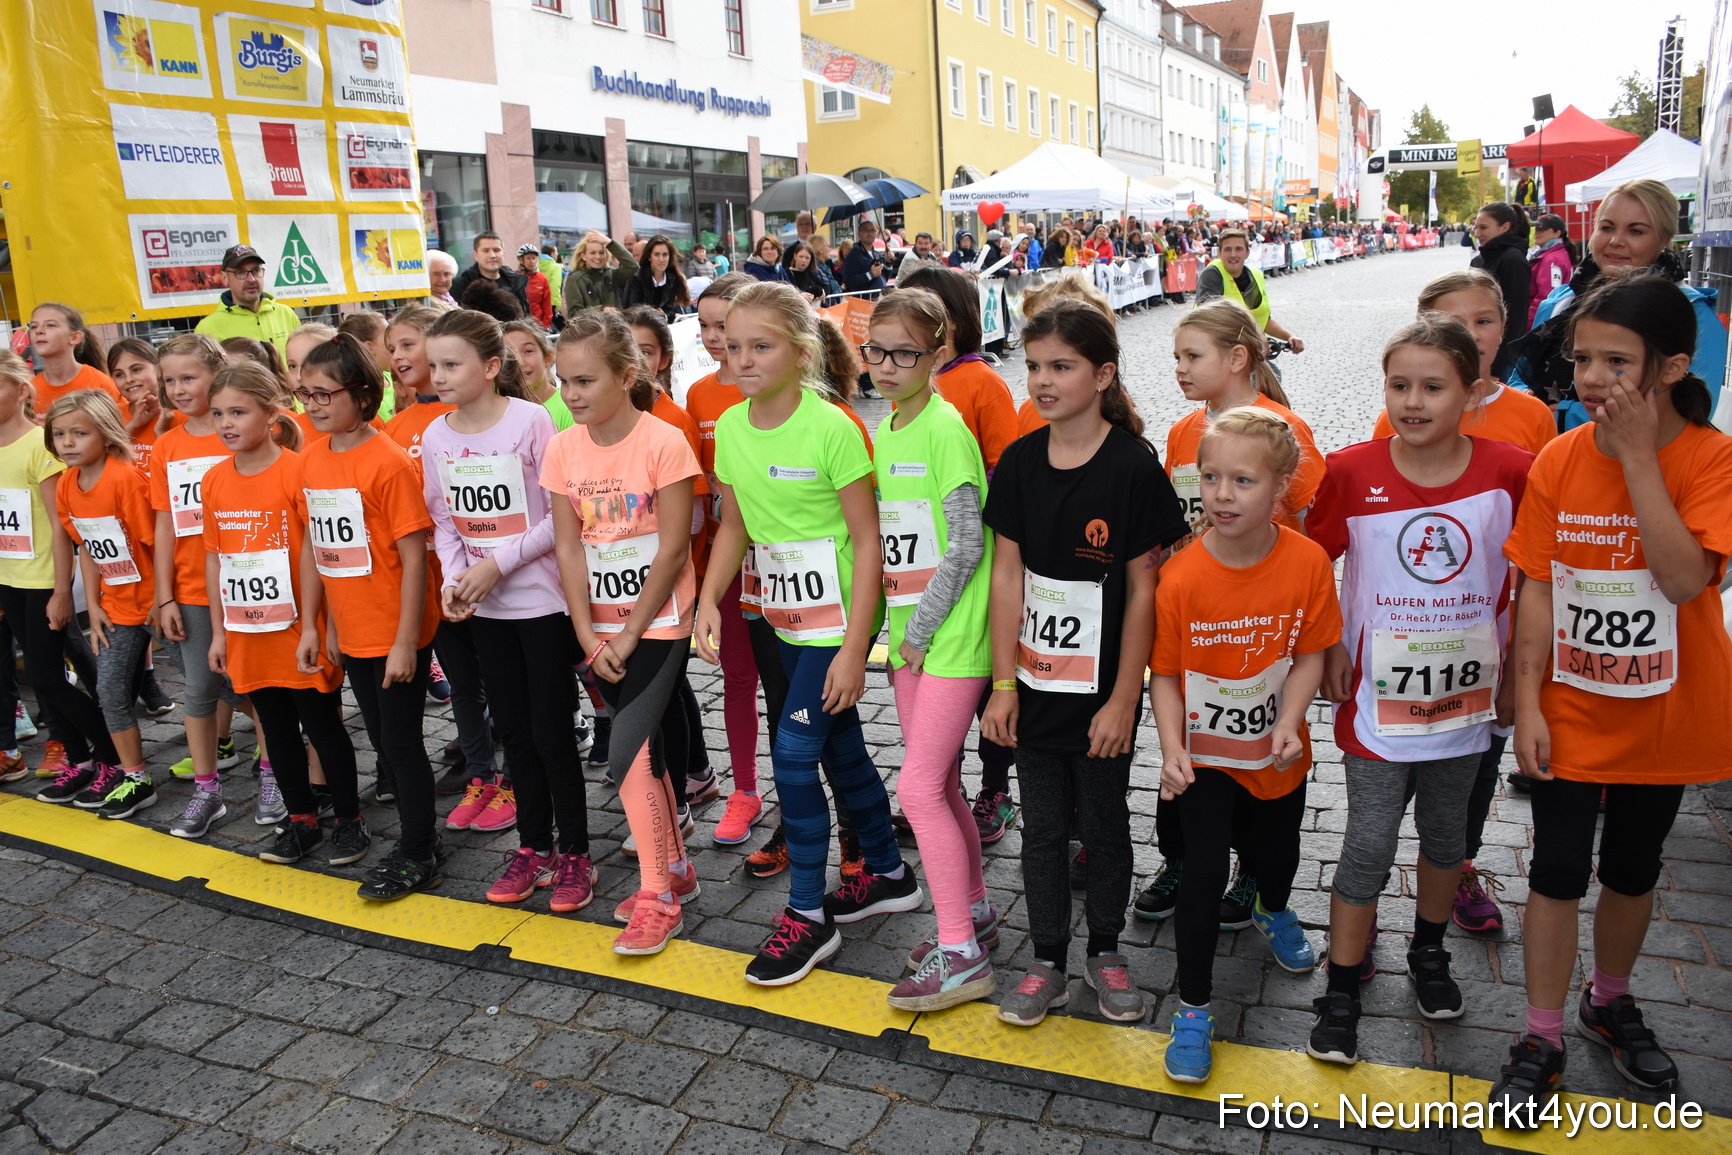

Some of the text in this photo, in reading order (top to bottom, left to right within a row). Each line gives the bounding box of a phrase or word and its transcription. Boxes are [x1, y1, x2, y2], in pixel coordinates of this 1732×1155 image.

[239, 40, 302, 73] Burgis
[160, 58, 198, 74] KANN
[350, 75, 395, 90] Neumarkter
[592, 65, 706, 112] Buchhandlung
[341, 86, 405, 106] Lammsbräu
[134, 143, 222, 166] PFLEIDERER
[1400, 149, 1434, 161] MINI
[266, 162, 302, 182] Braun
[971, 191, 1030, 200] ConnectedDrive
[169, 230, 227, 248] Egner
[397, 258, 423, 271] KANN
[463, 465, 493, 473] BOCK
[450, 484, 511, 512] 7060
[578, 487, 594, 496] YOU
[1365, 495, 1389, 503] erima
[467, 522, 497, 533] Sophia
[1557, 511, 1638, 527] Neumarkte
[310, 516, 354, 543] 7116
[1555, 530, 1627, 548] Stadtlauf
[602, 546, 638, 560] BOCK
[227, 576, 279, 602] 7193
[768, 570, 824, 602] 7110
[1035, 586, 1066, 601] BOCK
[1584, 582, 1635, 593] BOCK
[1375, 592, 1492, 607] LAUFEN MIT HERZ
[244, 610, 264, 621] Katja
[787, 612, 802, 624] Lili
[1190, 614, 1274, 633] Neumarkter
[1390, 613, 1404, 621] Dr.
[1406, 613, 1431, 622] Heck
[1440, 614, 1453, 622] Dr.
[1024, 605, 1081, 648] 7142
[1567, 603, 1657, 648] 7282
[1191, 630, 1257, 647] Stadtlauf
[1421, 639, 1466, 652] BOCK
[1029, 655, 1052, 672] Luisa
[1568, 647, 1662, 684] SARAH
[1391, 660, 1481, 696] 7118
[1231, 679, 1267, 697] BOCK
[1204, 693, 1278, 735] 7393
[1409, 699, 1463, 717] Charlotte
[790, 713, 811, 725] adidas
[646, 791, 665, 876] ACTIVE SQUAD
